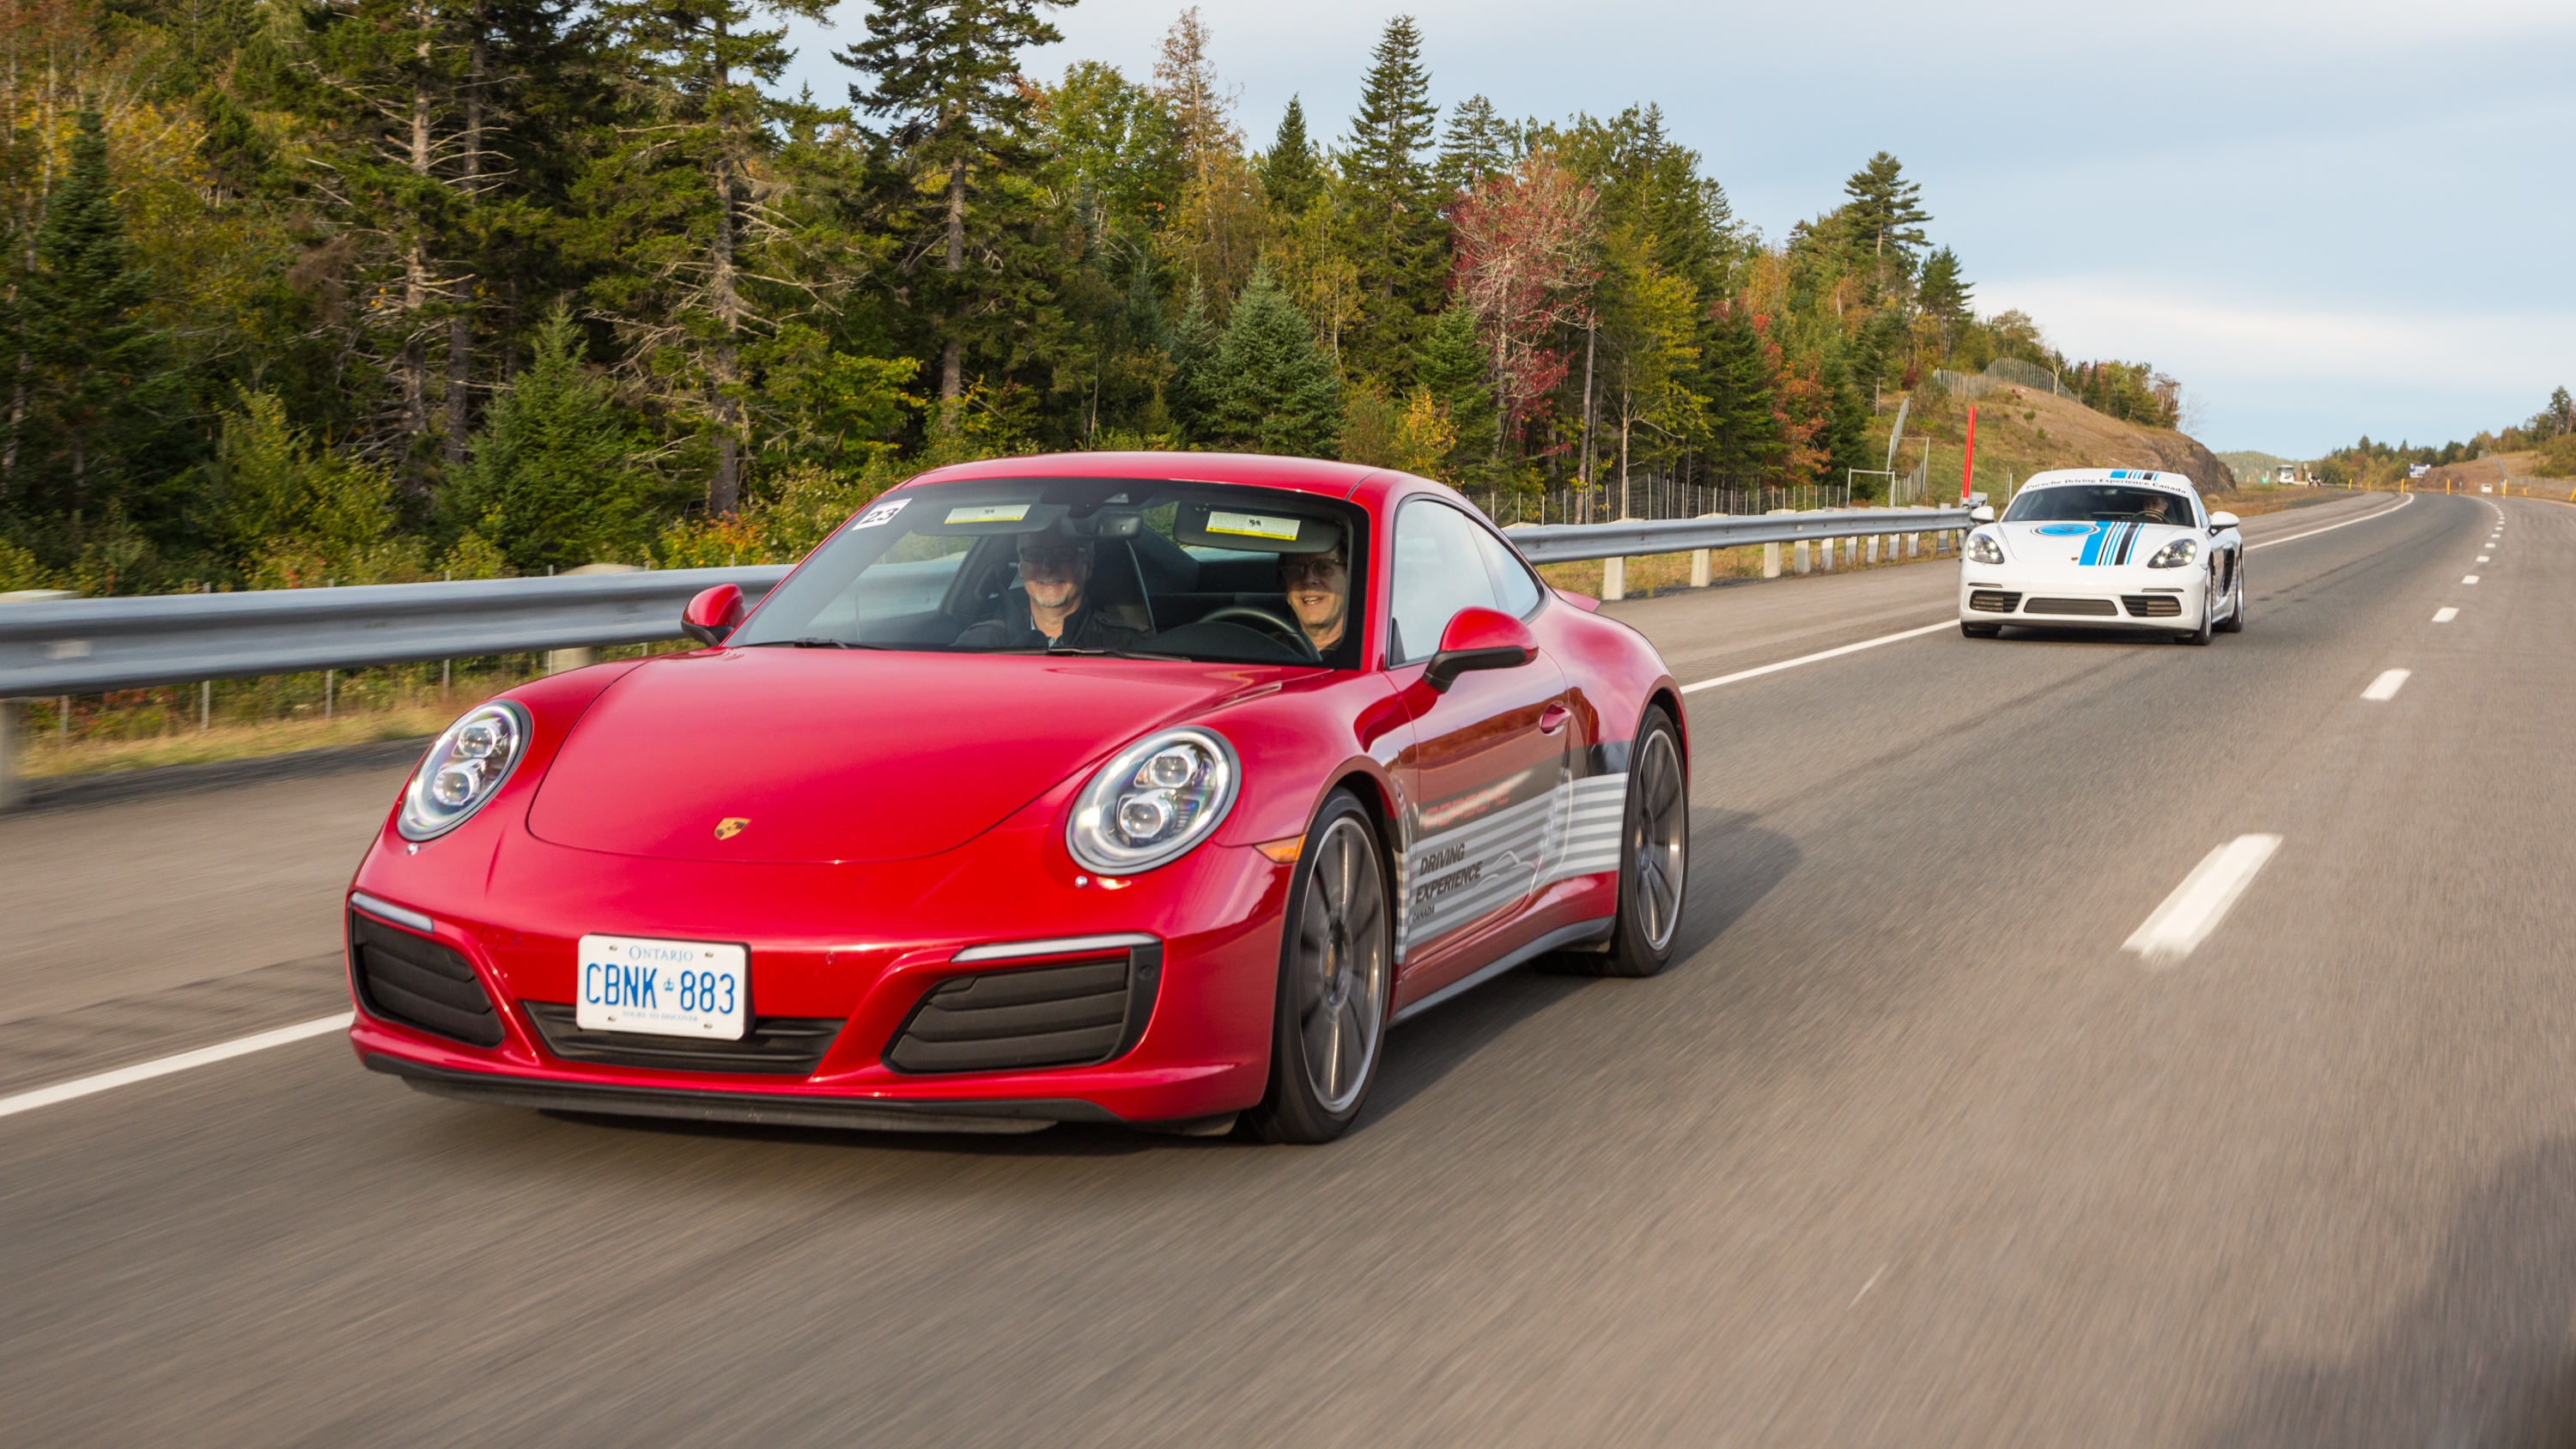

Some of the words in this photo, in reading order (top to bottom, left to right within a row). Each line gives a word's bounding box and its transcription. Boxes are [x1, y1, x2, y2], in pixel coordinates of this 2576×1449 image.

[2026, 480, 2062, 489] Porsche
[2099, 478, 2149, 487] Experience
[2153, 482, 2186, 494] Canada
[860, 507, 899, 524] 23
[1425, 780, 1510, 831] PORSCHE
[1419, 843, 1465, 876] DRIVING
[1415, 861, 1483, 905] EXPERIENCE
[1413, 904, 1435, 923] CANADA
[629, 945, 693, 962] ONTARIO
[586, 963, 658, 1009] CBNK
[680, 970, 735, 1015] 883
